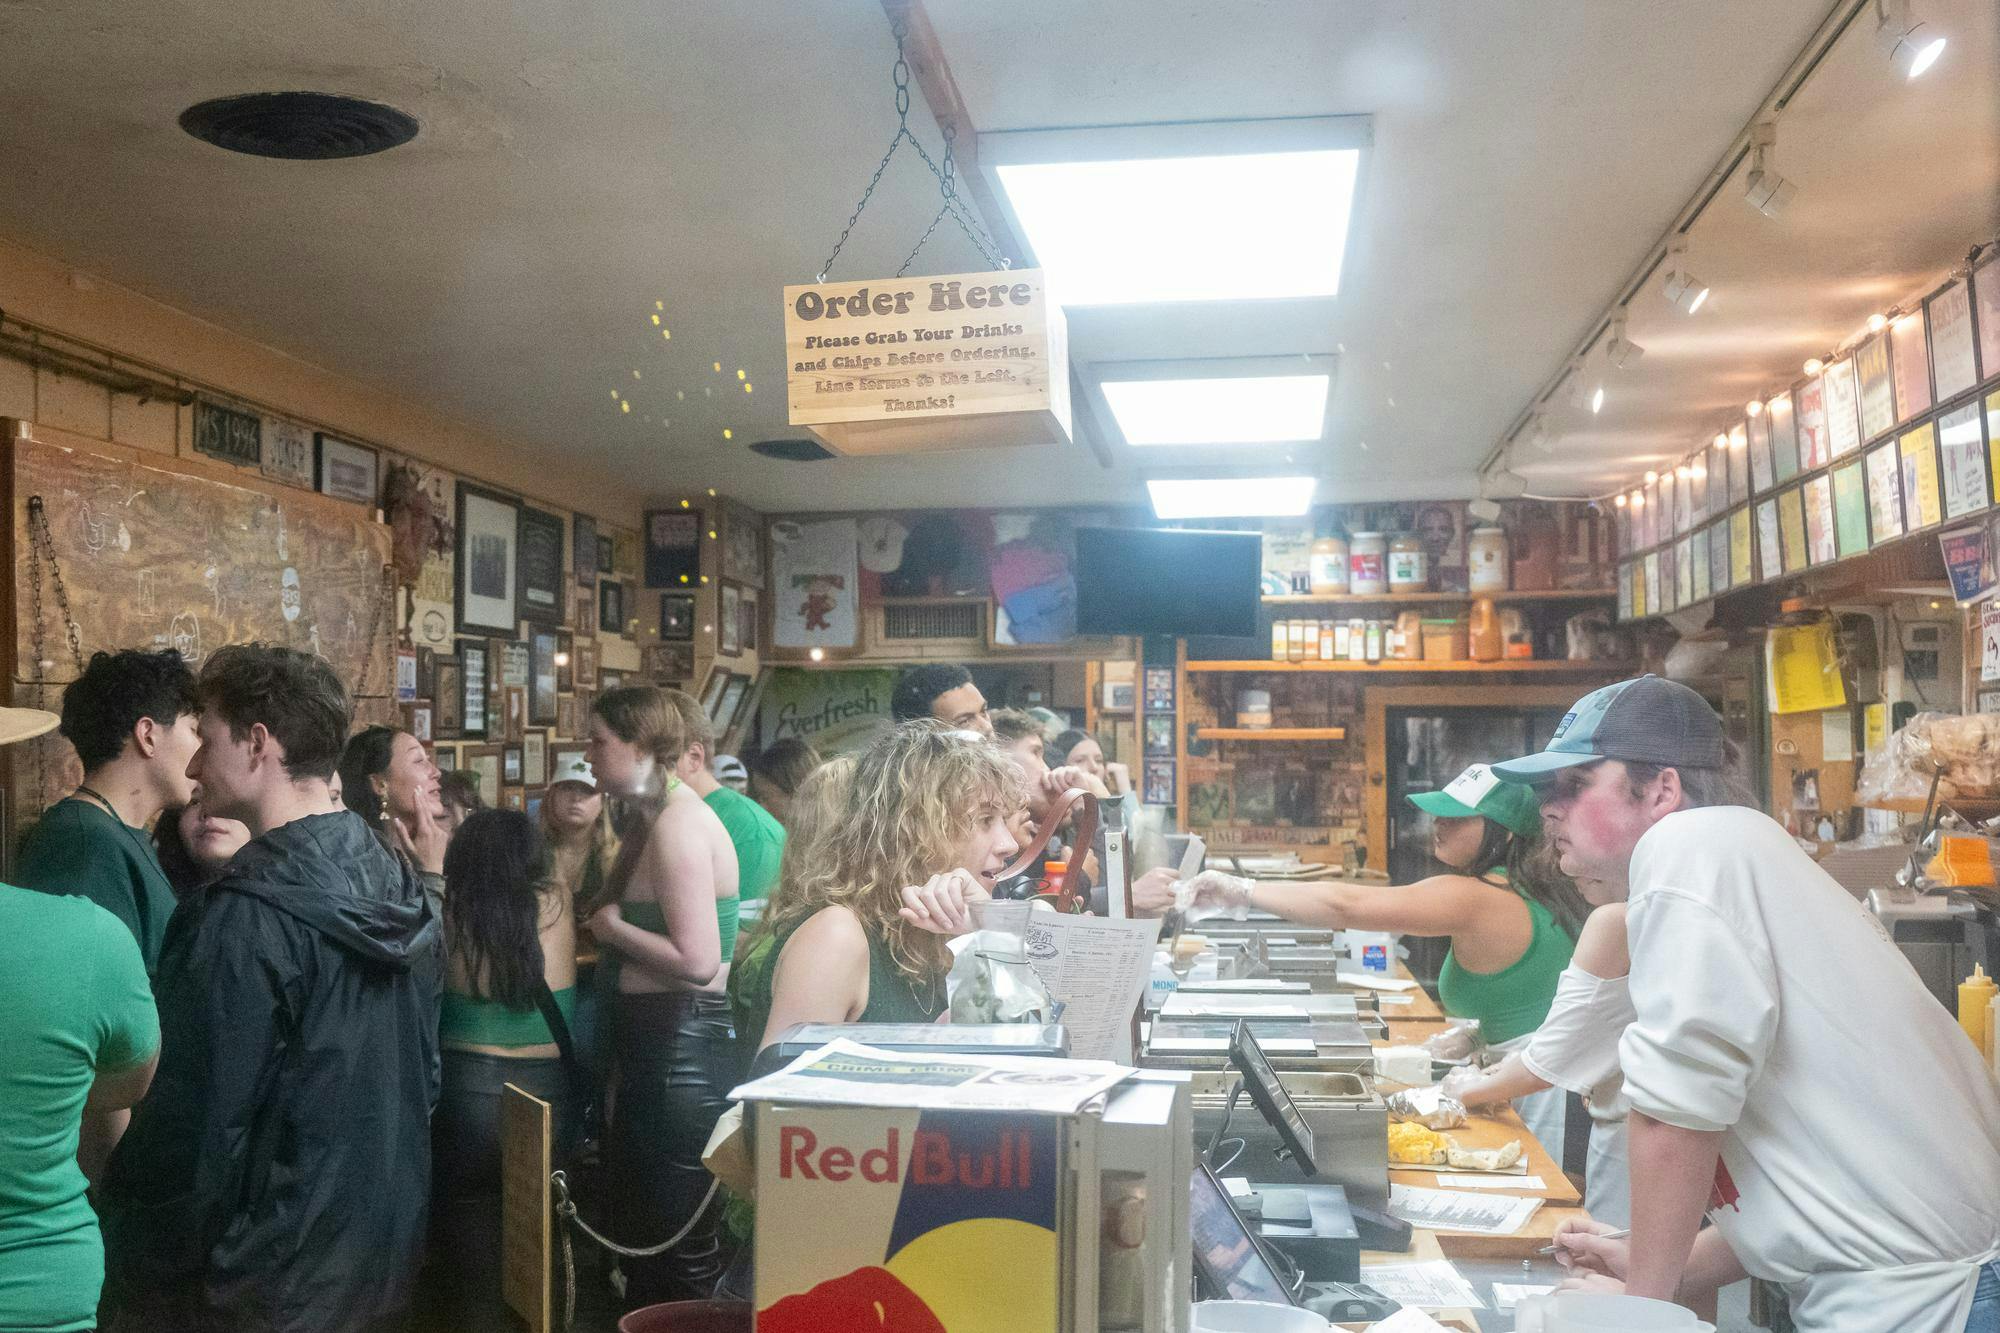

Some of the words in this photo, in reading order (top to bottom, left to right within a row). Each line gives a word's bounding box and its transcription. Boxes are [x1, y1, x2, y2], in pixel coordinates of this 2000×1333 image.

[795, 287, 915, 321] Order
[928, 281, 1032, 312] Here
[805, 334, 860, 349] Please
[865, 330, 908, 344] Grab
[913, 327, 955, 342] Your
[961, 322, 1023, 338] Drinks
[795, 357, 827, 372] and
[832, 355, 882, 370] Chips
[887, 351, 945, 366] Before
[950, 345, 1036, 362] Ordering.
[815, 380, 854, 394] Line
[775, 687, 879, 740] Everfresh
[780, 1126, 898, 1184] Red
[911, 1124, 1031, 1189] Bull
